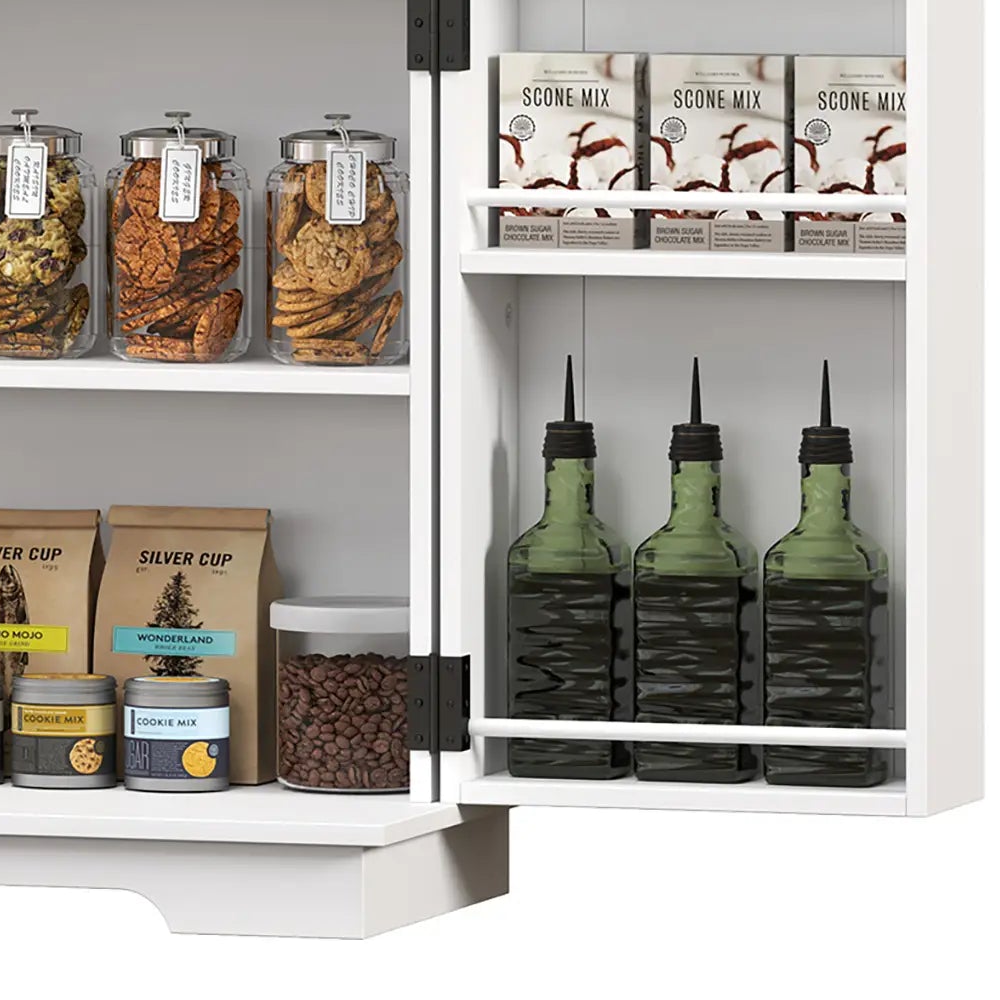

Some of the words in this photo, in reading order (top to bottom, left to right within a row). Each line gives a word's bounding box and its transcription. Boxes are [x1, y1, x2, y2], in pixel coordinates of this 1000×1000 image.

[522, 86, 574, 108] SCONE
[582, 86, 610, 108] MIX
[674, 88, 726, 110] SCONE
[733, 88, 761, 110] MIX
[818, 90, 870, 112] SCONE
[878, 90, 906, 112] MIX
[22, 156, 30, 204] OATMEAL
[654, 236, 691, 244] CHOCOLATE
[692, 236, 705, 244] MIX
[799, 238, 836, 246] CHOCOLATE
[837, 238, 849, 246] MIX
[28, 547, 62, 561] CUP
[138, 550, 194, 566] SILVER
[198, 552, 233, 567] CUP
[12, 630, 44, 640] MOJO
[137, 634, 214, 644] WONDERLAND
[24, 714, 62, 724] COOKIE
[64, 714, 84, 724] MIX
[136, 718, 174, 727] COOKIE
[177, 718, 197, 727] MIX
